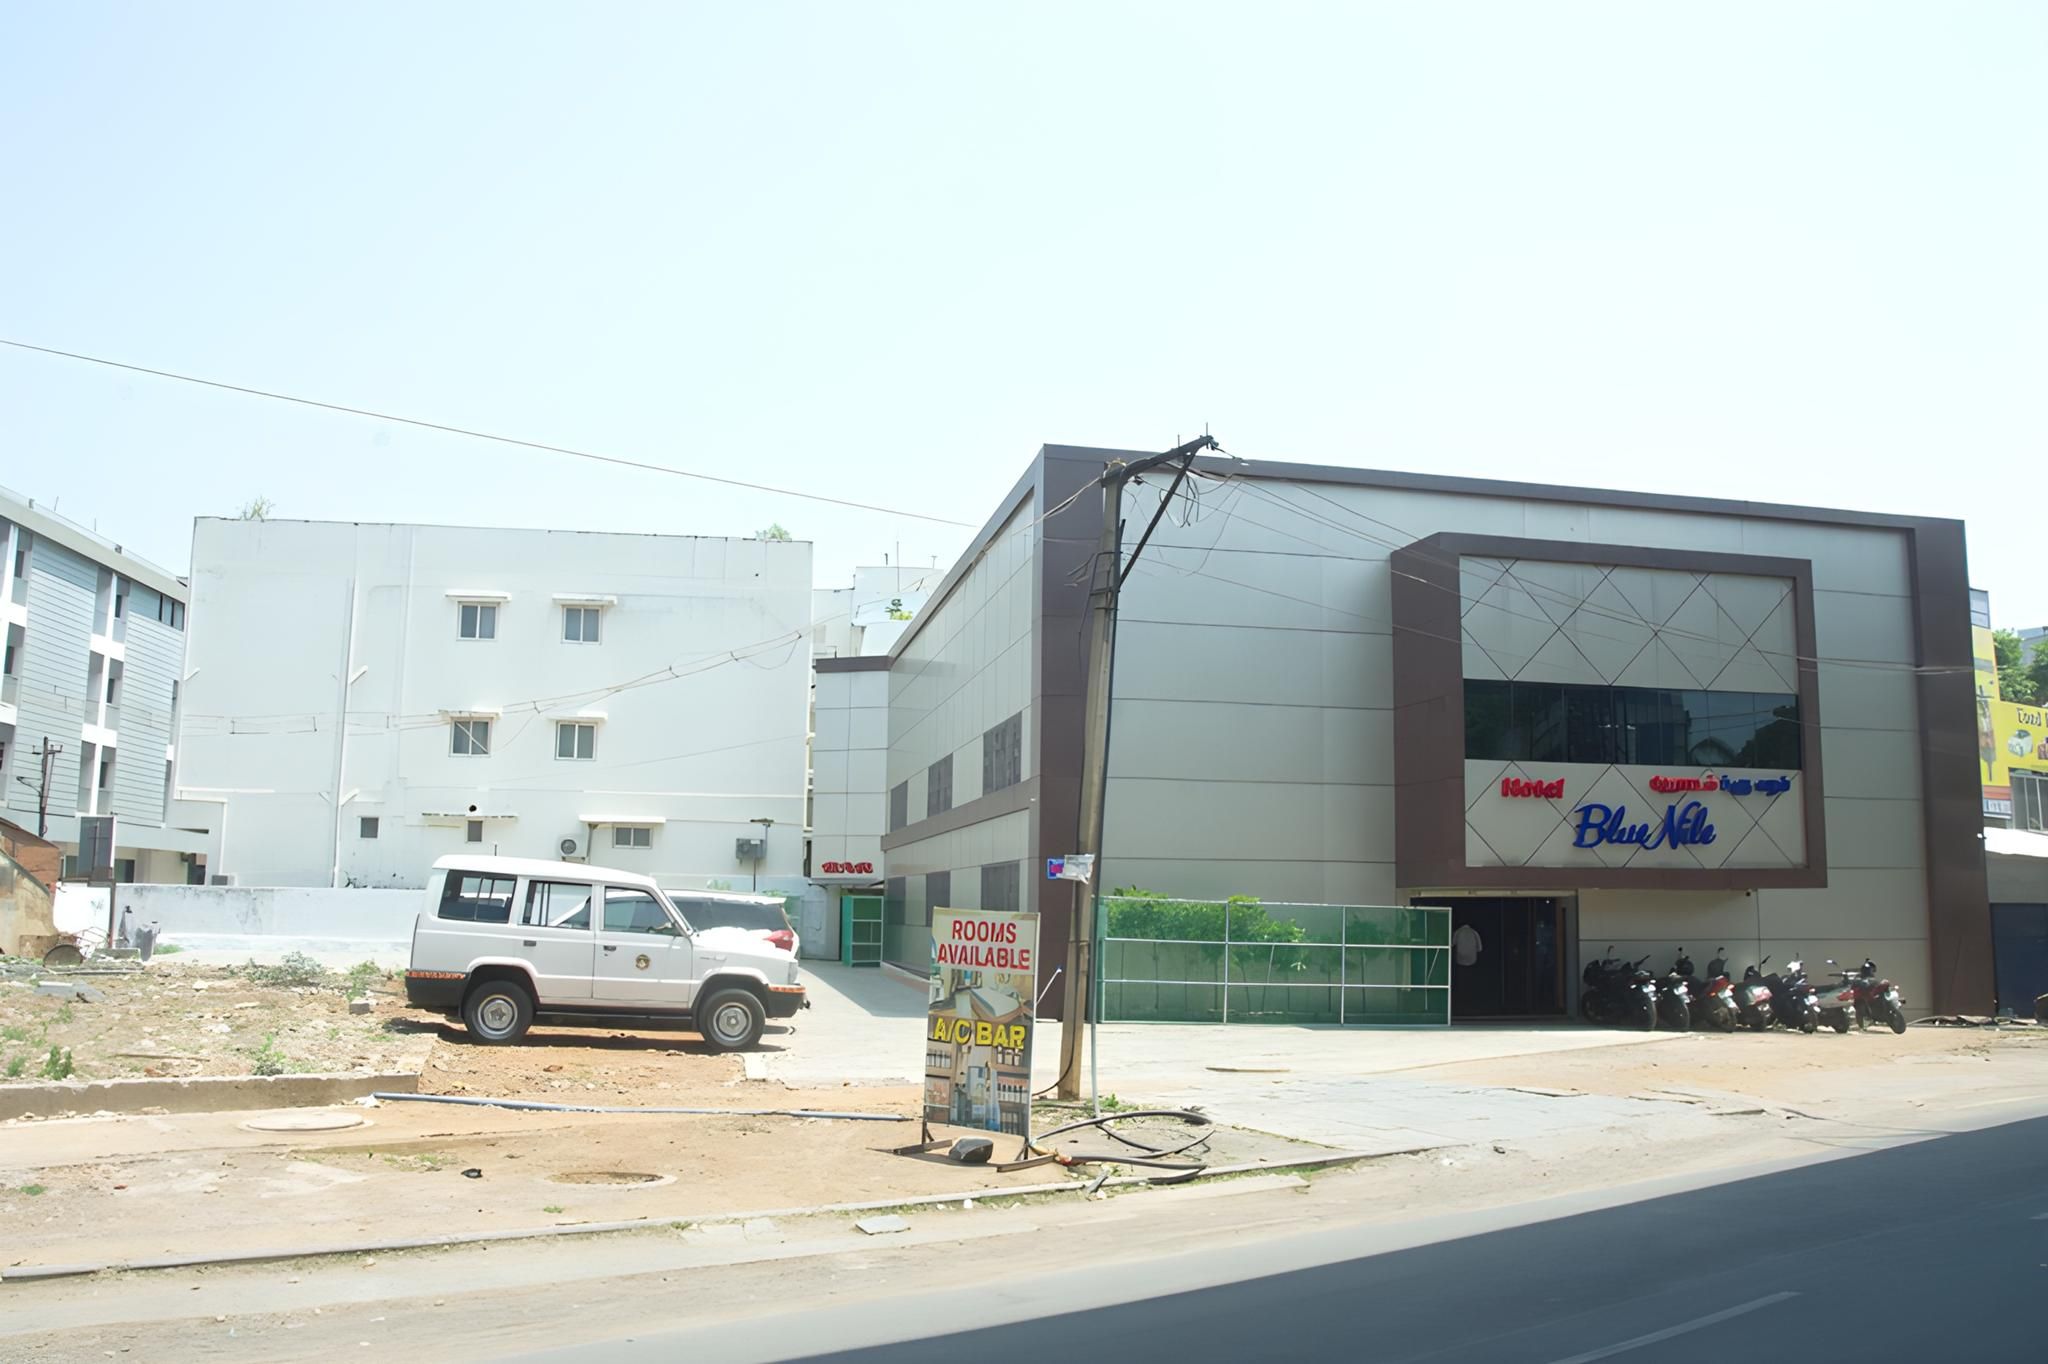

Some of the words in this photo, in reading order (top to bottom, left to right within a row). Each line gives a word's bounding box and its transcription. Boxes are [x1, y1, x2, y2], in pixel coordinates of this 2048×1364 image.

[1573, 803, 1651, 848] Blue
[1642, 800, 1717, 850] Nile
[952, 920, 1017, 944] ROOMS
[937, 943, 1030, 970] AVAILABLE
[933, 1017, 972, 1045] A/C
[975, 1020, 1026, 1049] BAR
